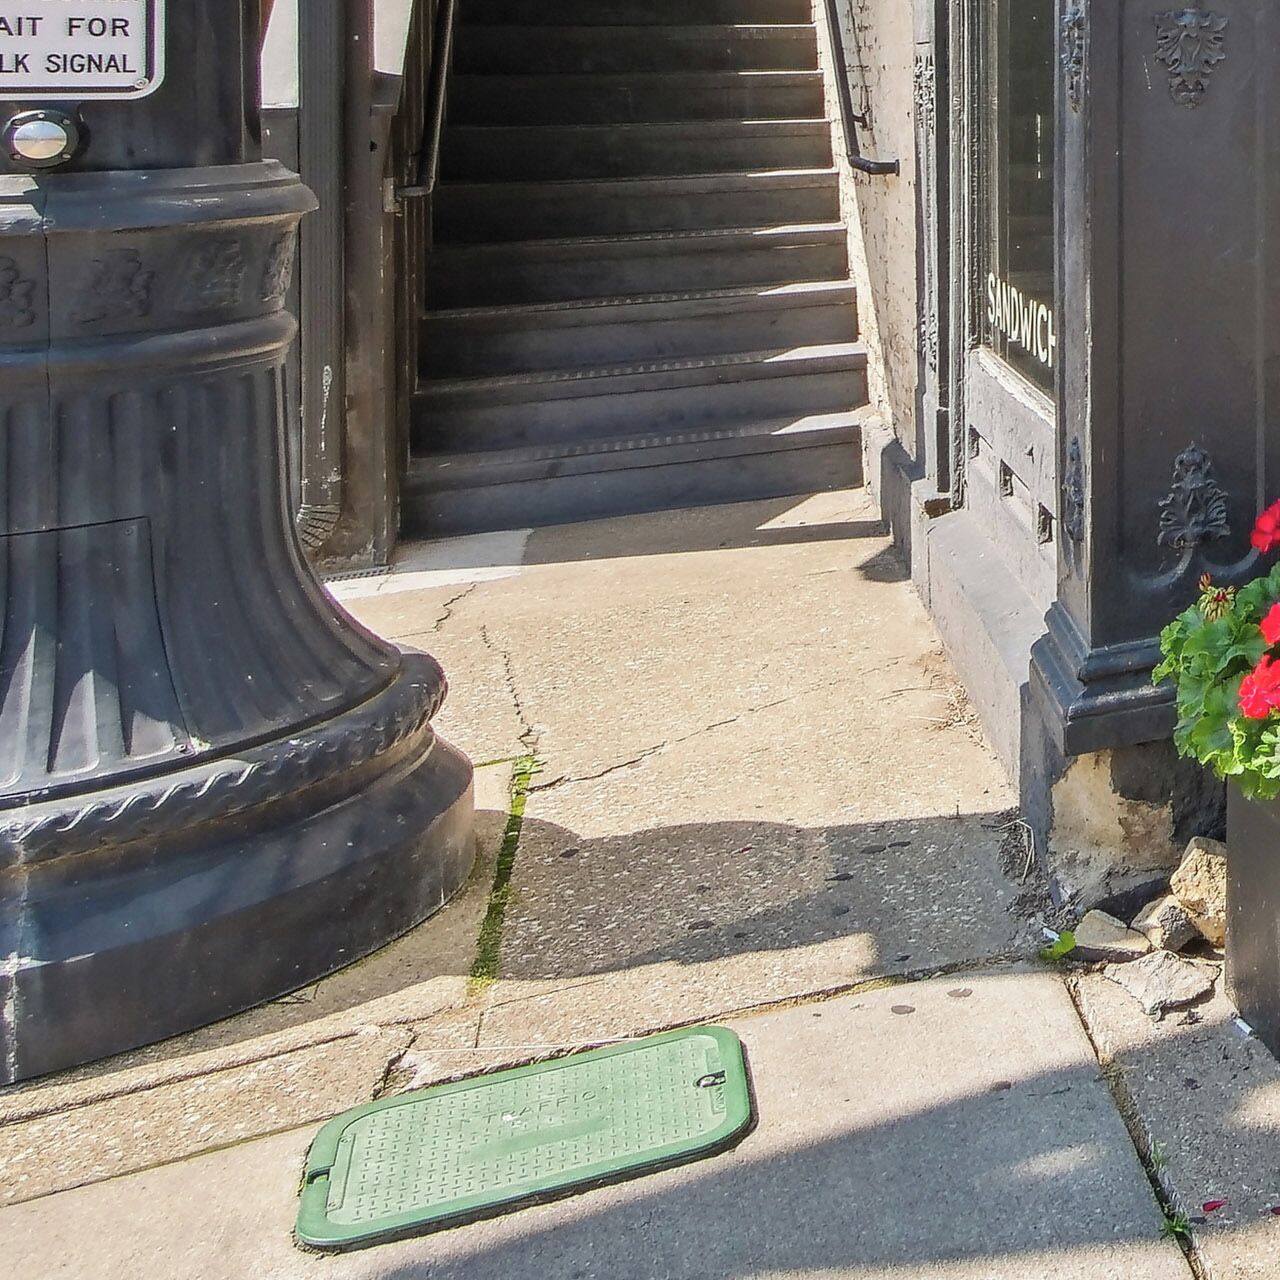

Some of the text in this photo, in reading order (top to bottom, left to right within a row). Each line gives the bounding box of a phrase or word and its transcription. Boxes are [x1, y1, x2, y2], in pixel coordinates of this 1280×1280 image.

[0, 16, 130, 37] AIT FOR
[0, 53, 137, 73] LK SIGNAL
